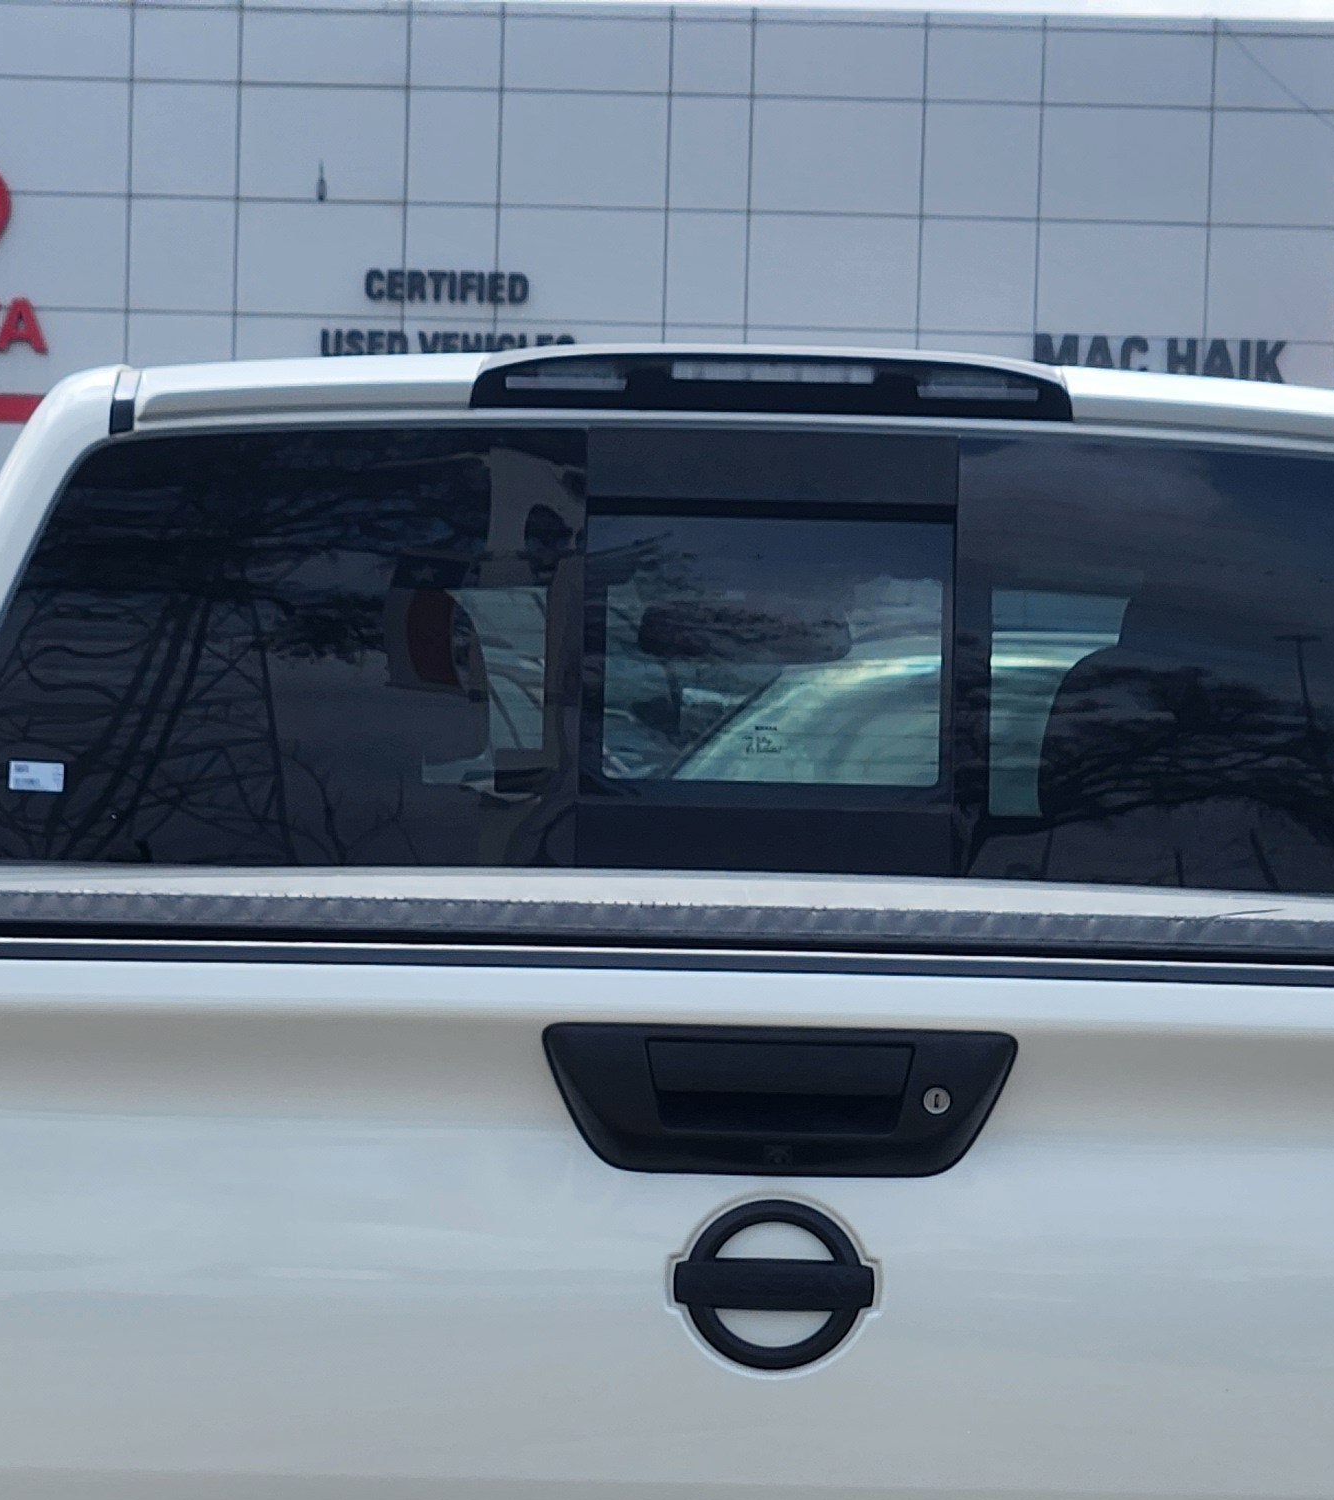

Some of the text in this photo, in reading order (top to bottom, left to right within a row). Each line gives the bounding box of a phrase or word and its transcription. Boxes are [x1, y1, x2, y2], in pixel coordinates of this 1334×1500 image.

[364, 268, 530, 305] CERTIFIED
[320, 328, 409, 357] USED
[1034, 333, 1287, 384] MAC HAIK
